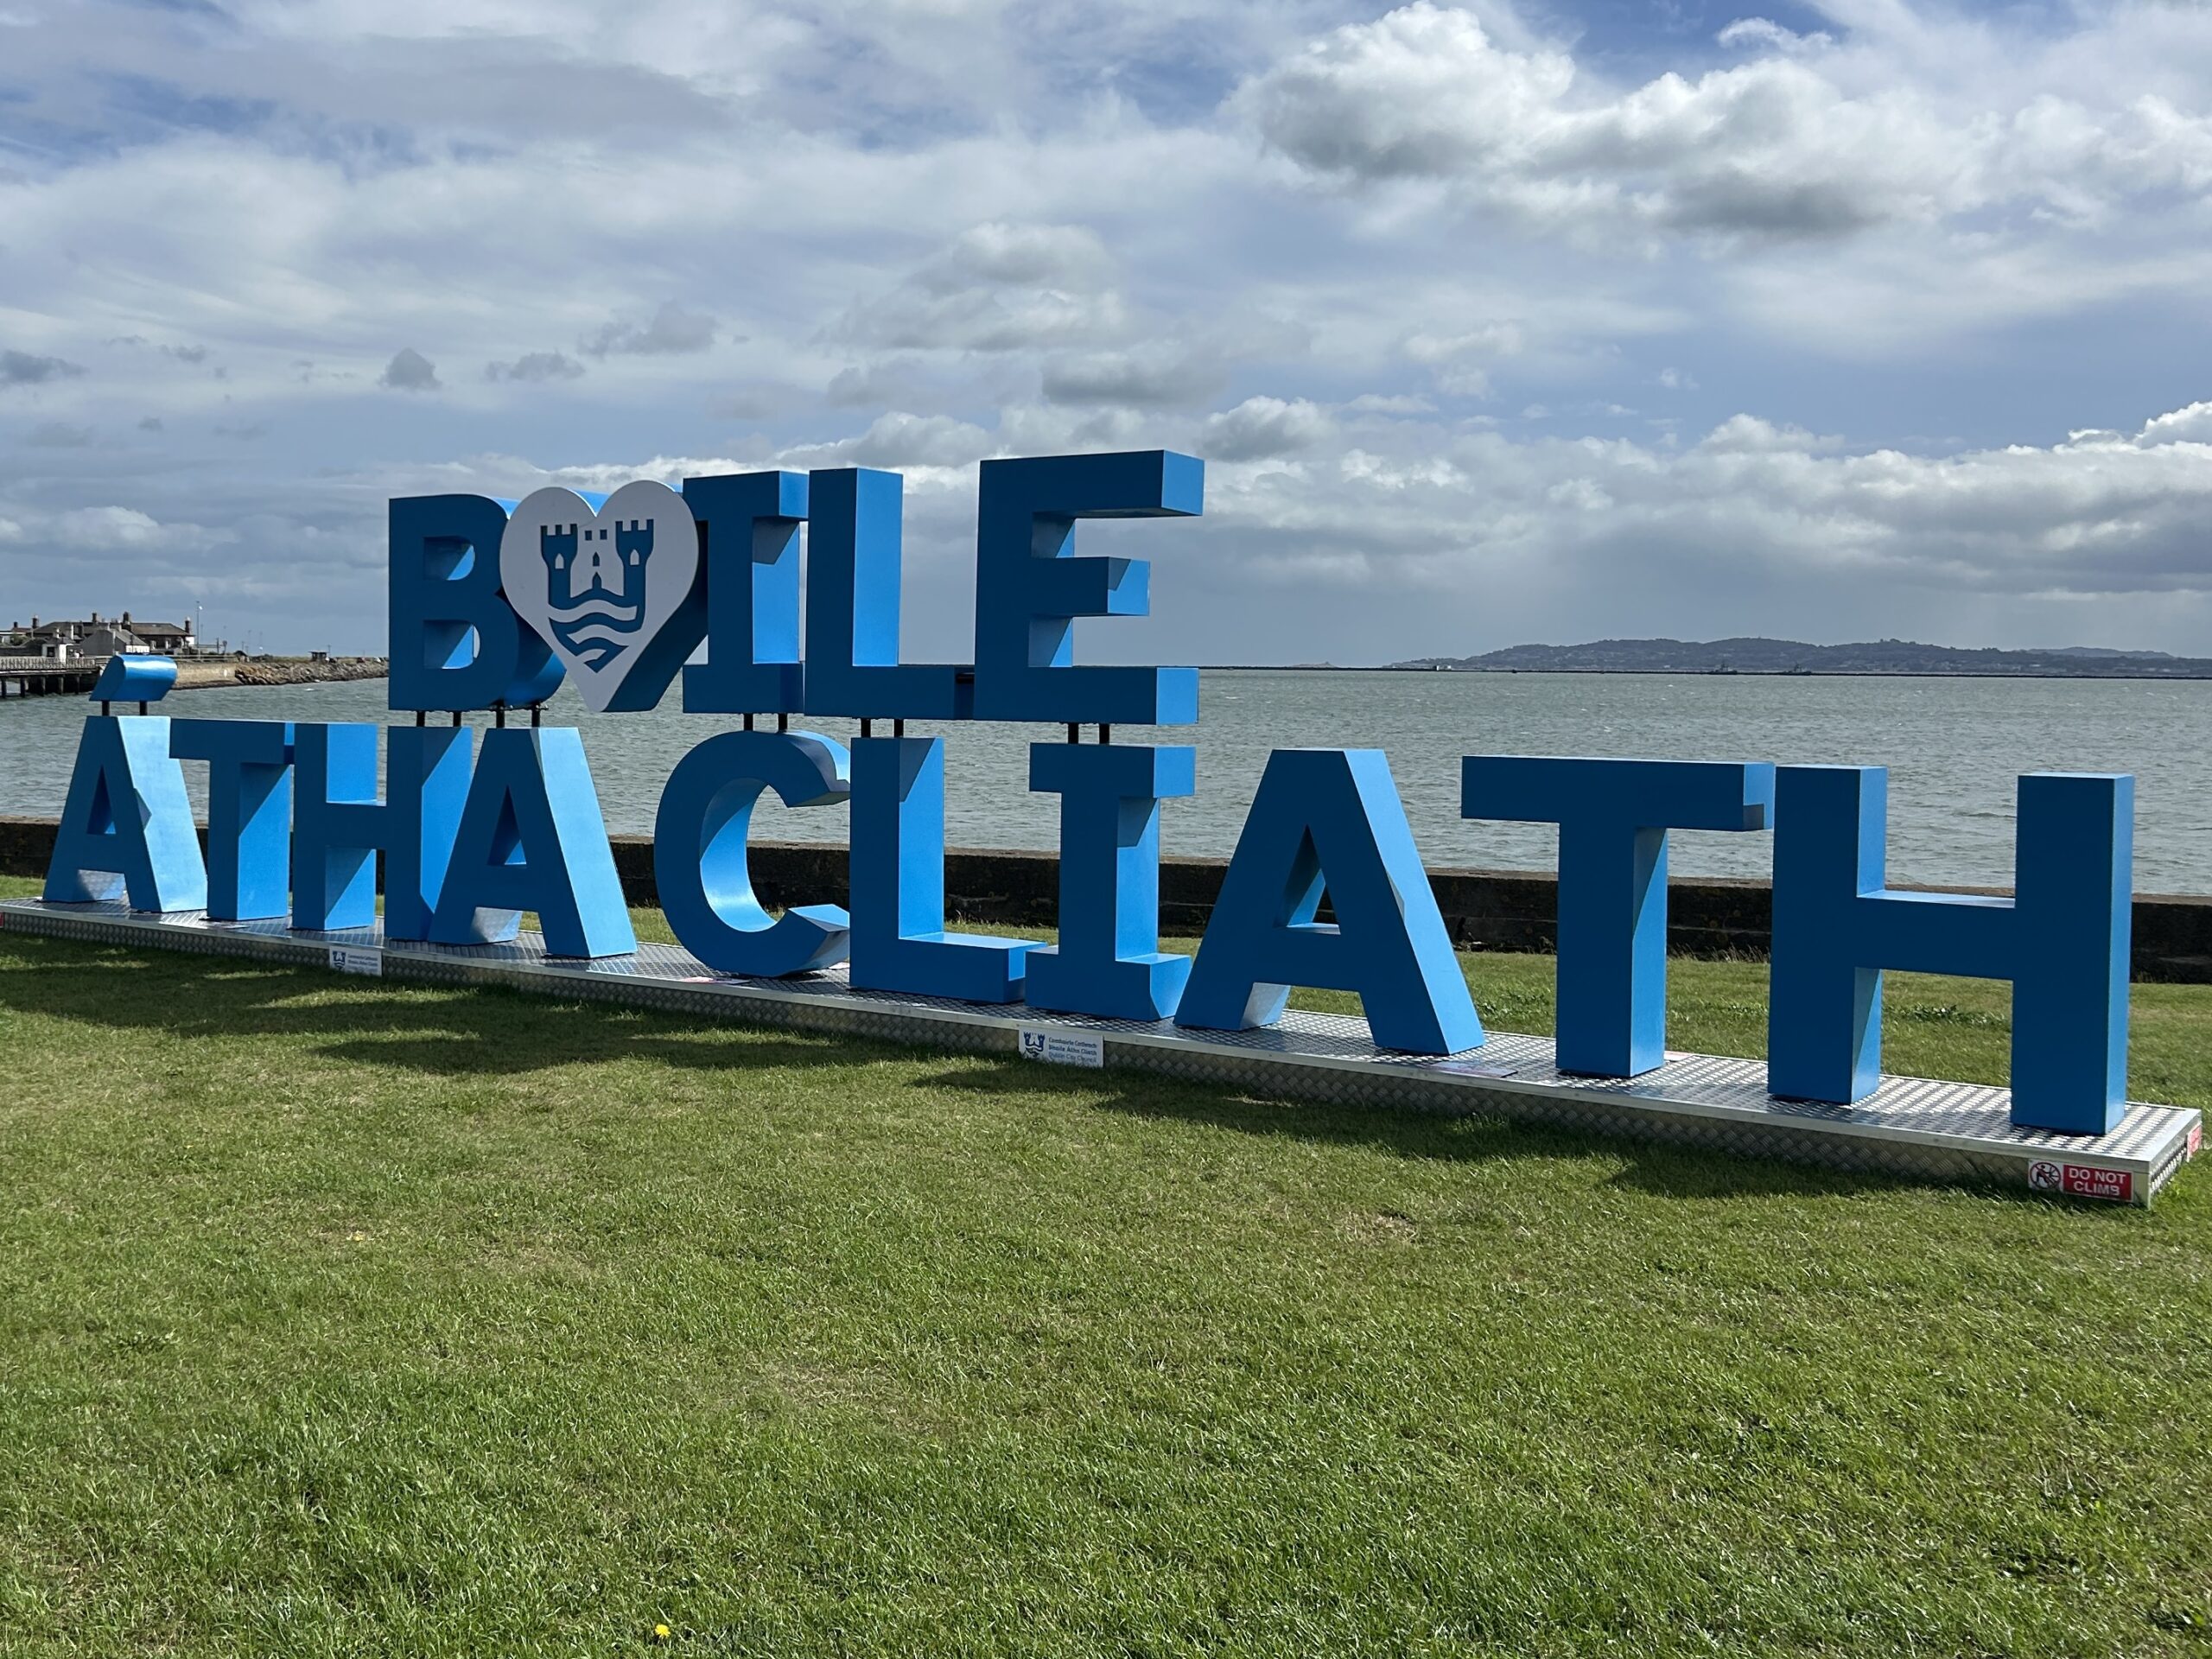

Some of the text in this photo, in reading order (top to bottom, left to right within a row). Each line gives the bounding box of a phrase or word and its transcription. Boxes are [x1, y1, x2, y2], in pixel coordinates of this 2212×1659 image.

[42, 653, 2135, 1136] ÁTHA CLIATH
[2069, 1167, 2126, 1185] DO NOT
[2074, 1180, 2120, 1196] CLIMB
